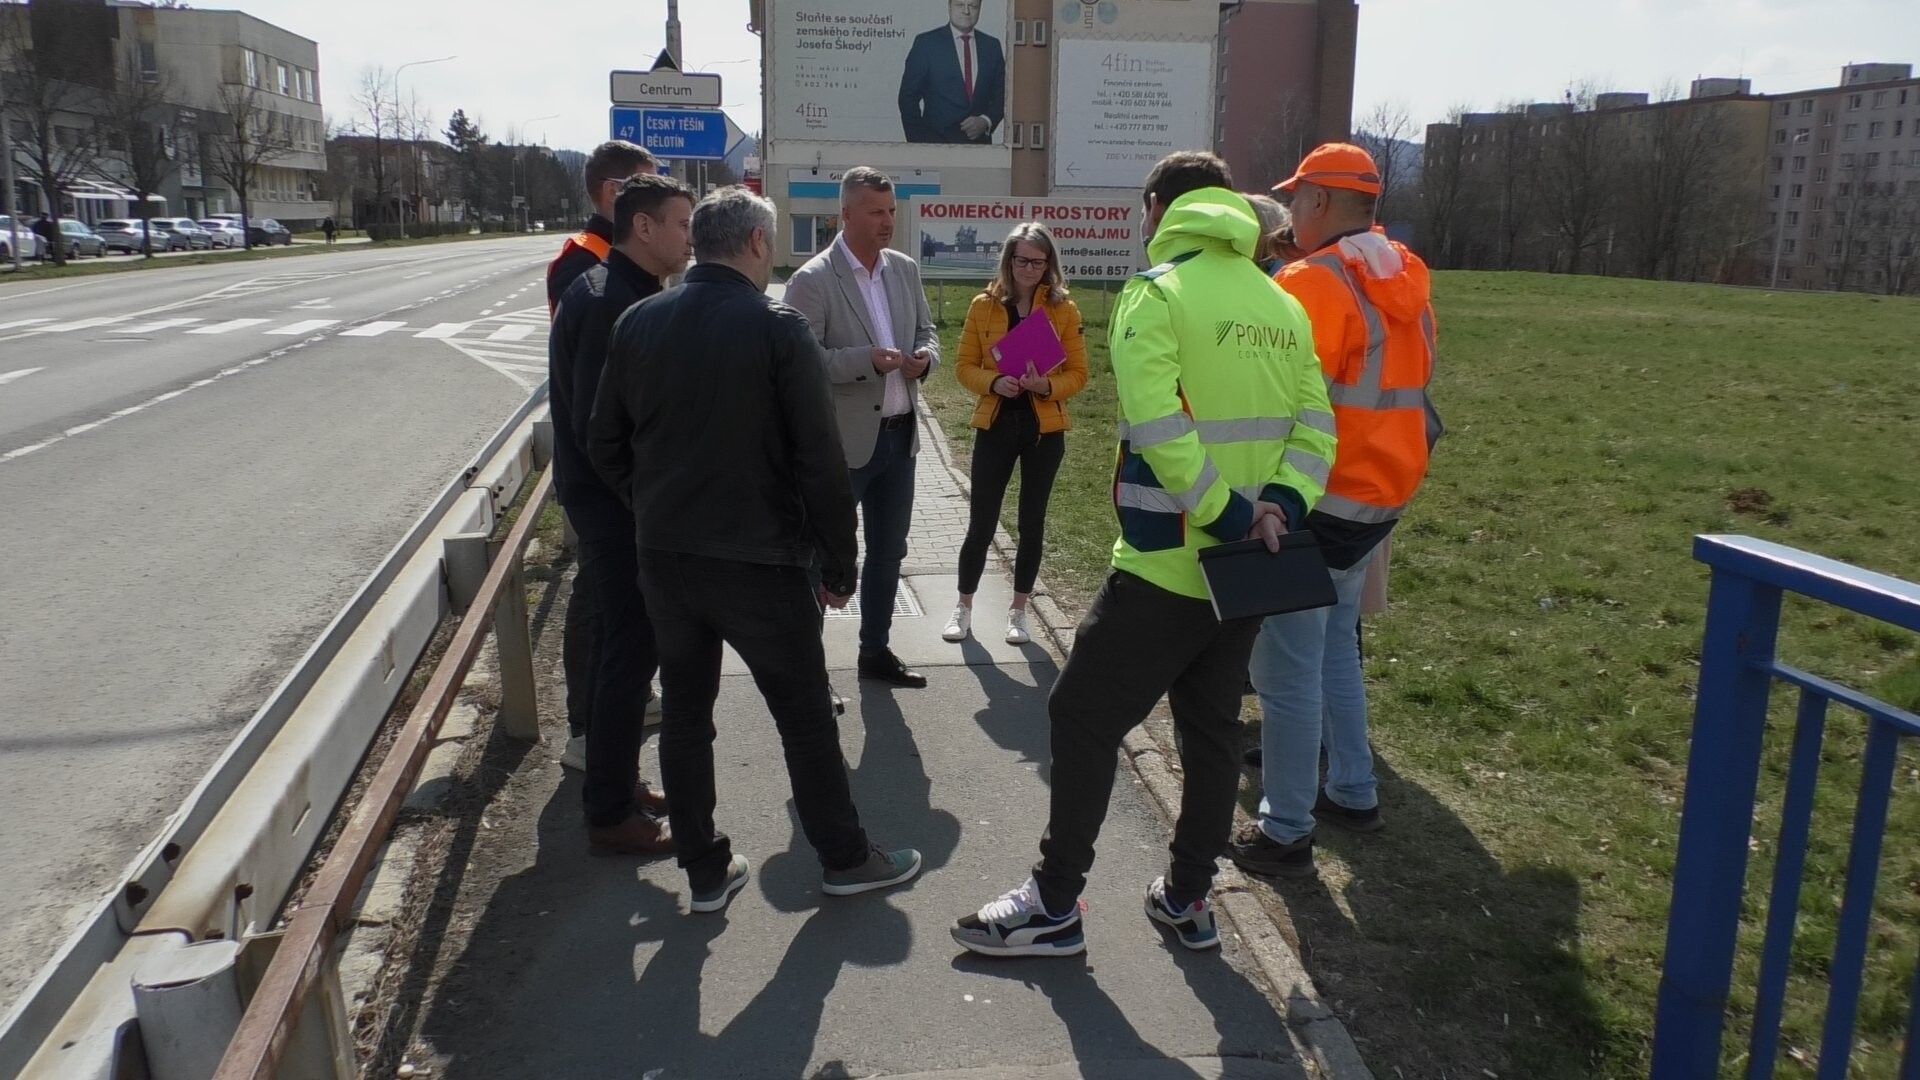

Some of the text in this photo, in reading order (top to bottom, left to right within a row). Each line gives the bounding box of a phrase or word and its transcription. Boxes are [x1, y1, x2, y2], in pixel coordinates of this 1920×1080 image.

[796, 11, 893, 25] Staňte se součástí
[796, 26, 906, 39] zemského ředitelství
[796, 37, 872, 54] Josefa Škody!
[1101, 53, 1143, 73] 4fin
[639, 83, 692, 96] Centrum
[1134, 80, 1163, 88] centrum
[795, 102, 828, 118] 4fin
[620, 116, 705, 138] 47 ČESKÝ TĚŠÍN
[646, 133, 685, 148] BĚLOTÍN
[920, 201, 1132, 221] KOMERČNÍ PROSTORY
[1048, 225, 1131, 240] RONÁJMU
[1060, 247, 1131, 257] info@saller.cz
[1061, 265, 1129, 276] 24 666 857
[1235, 323, 1298, 351] PONVIA
